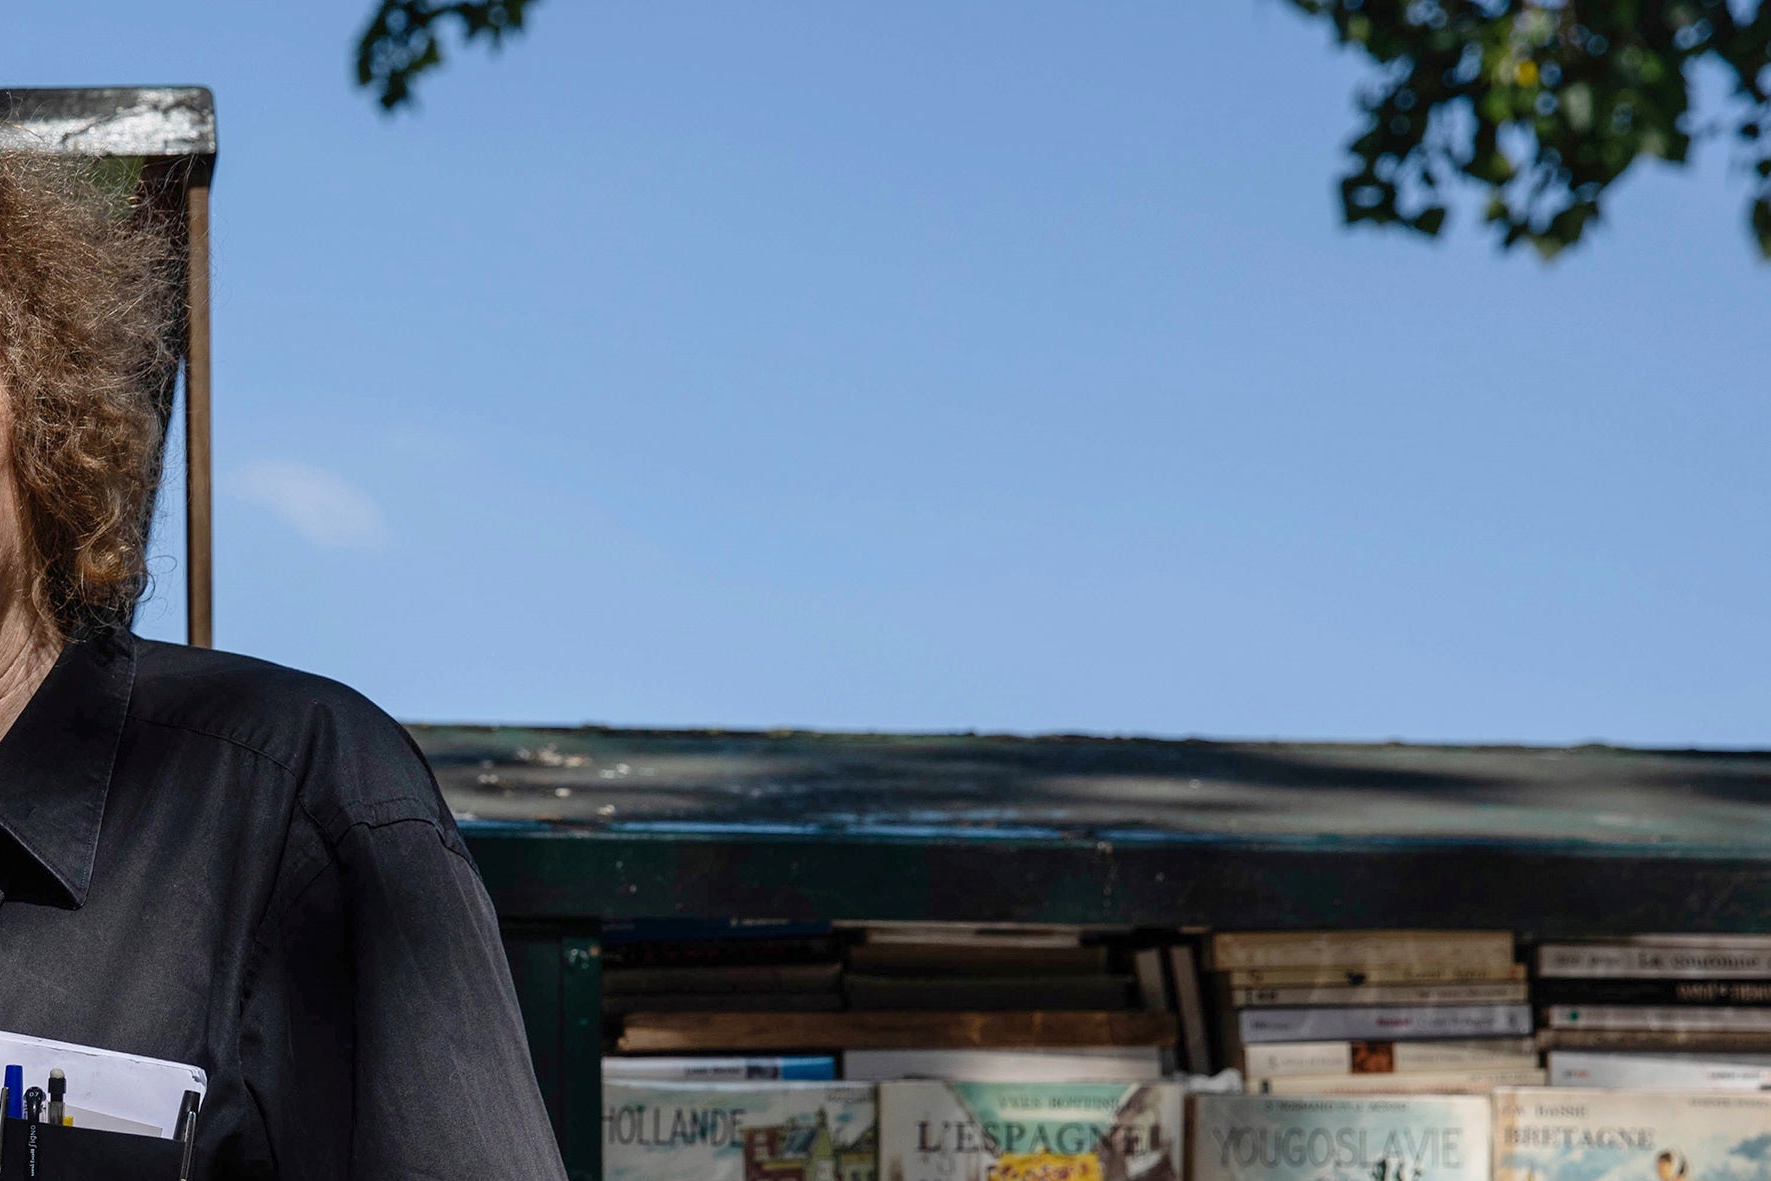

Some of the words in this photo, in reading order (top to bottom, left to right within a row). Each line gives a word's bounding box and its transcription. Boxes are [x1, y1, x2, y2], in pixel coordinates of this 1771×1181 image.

[917, 1119, 1150, 1156] L'ESPAGNE
[1211, 1126, 1465, 1170] YOUGOSLAVIE
[1503, 1125, 1655, 1150] BRETAGNE
